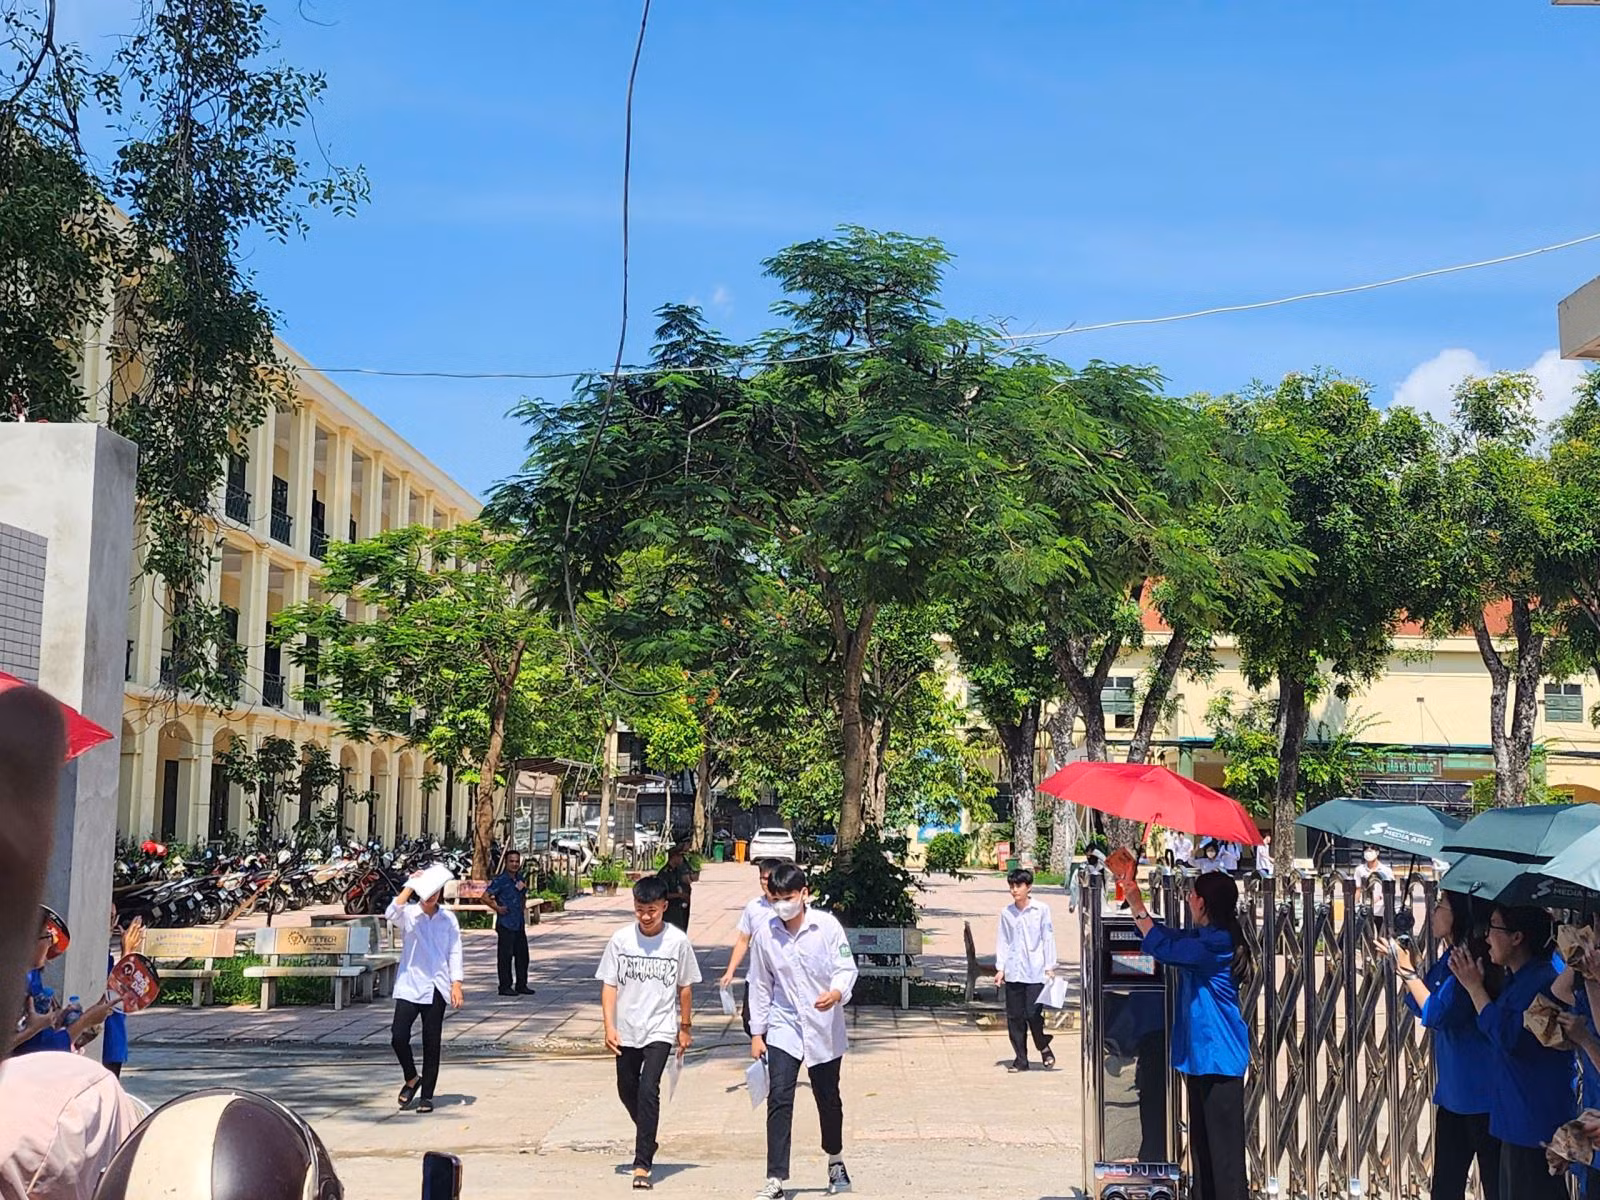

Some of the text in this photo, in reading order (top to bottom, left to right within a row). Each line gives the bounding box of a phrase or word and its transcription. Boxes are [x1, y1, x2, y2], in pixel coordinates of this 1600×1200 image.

[1384, 829, 1410, 841] MEDIA
[1410, 836, 1433, 847] ARTS
[1553, 888, 1584, 897] MEDIA
